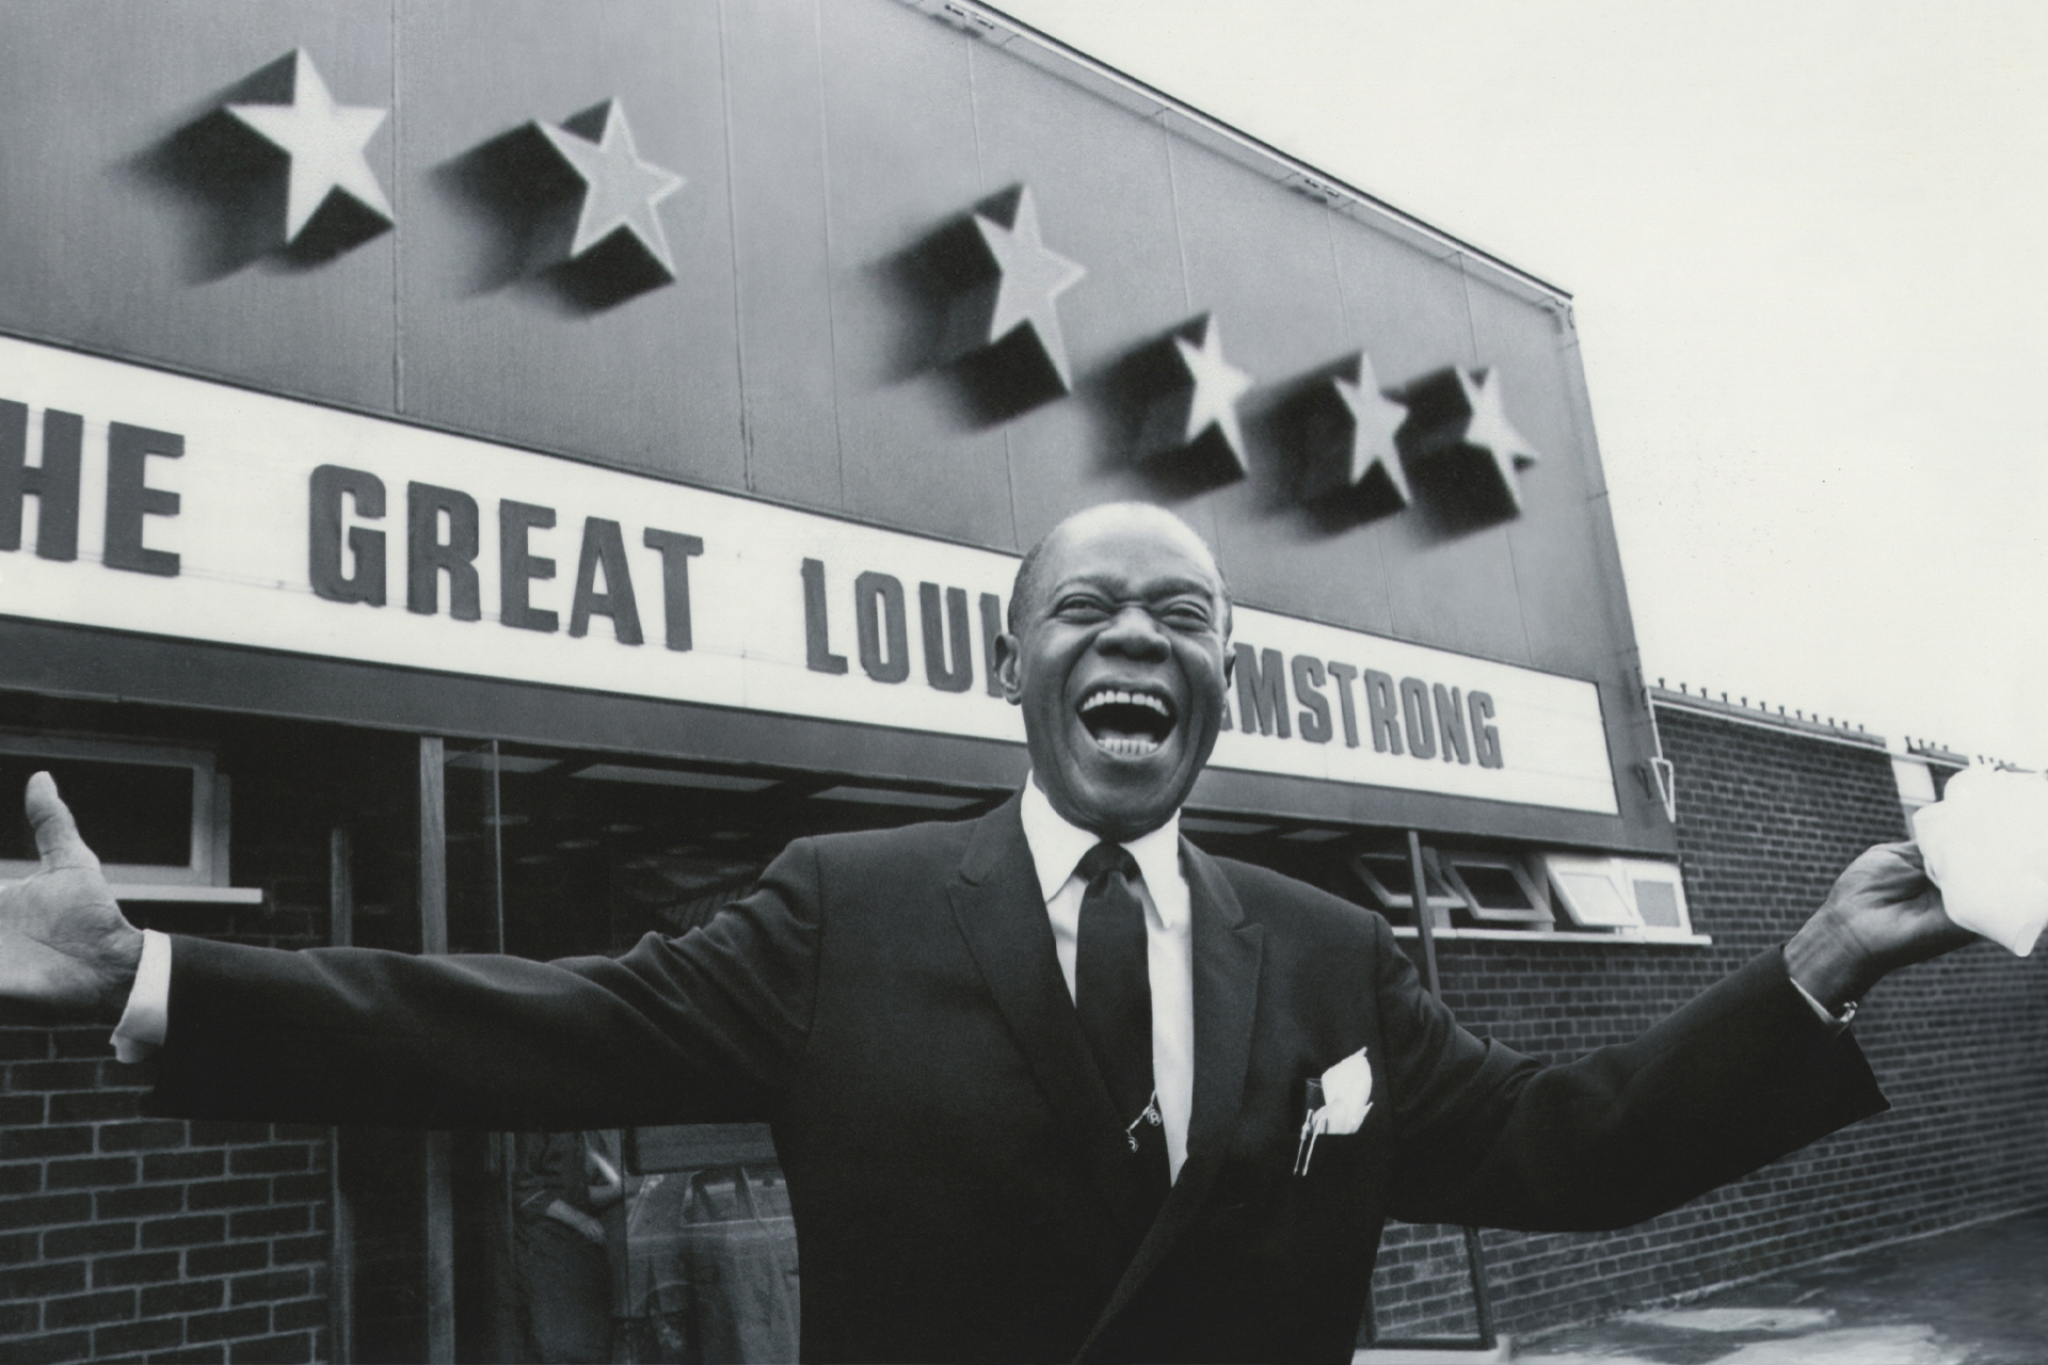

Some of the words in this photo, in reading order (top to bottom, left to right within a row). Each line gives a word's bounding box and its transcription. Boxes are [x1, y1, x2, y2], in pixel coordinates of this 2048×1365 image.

[0, 397, 185, 577] HE
[309, 464, 704, 651] GREAT
[1220, 642, 1504, 769] MSTRONG
